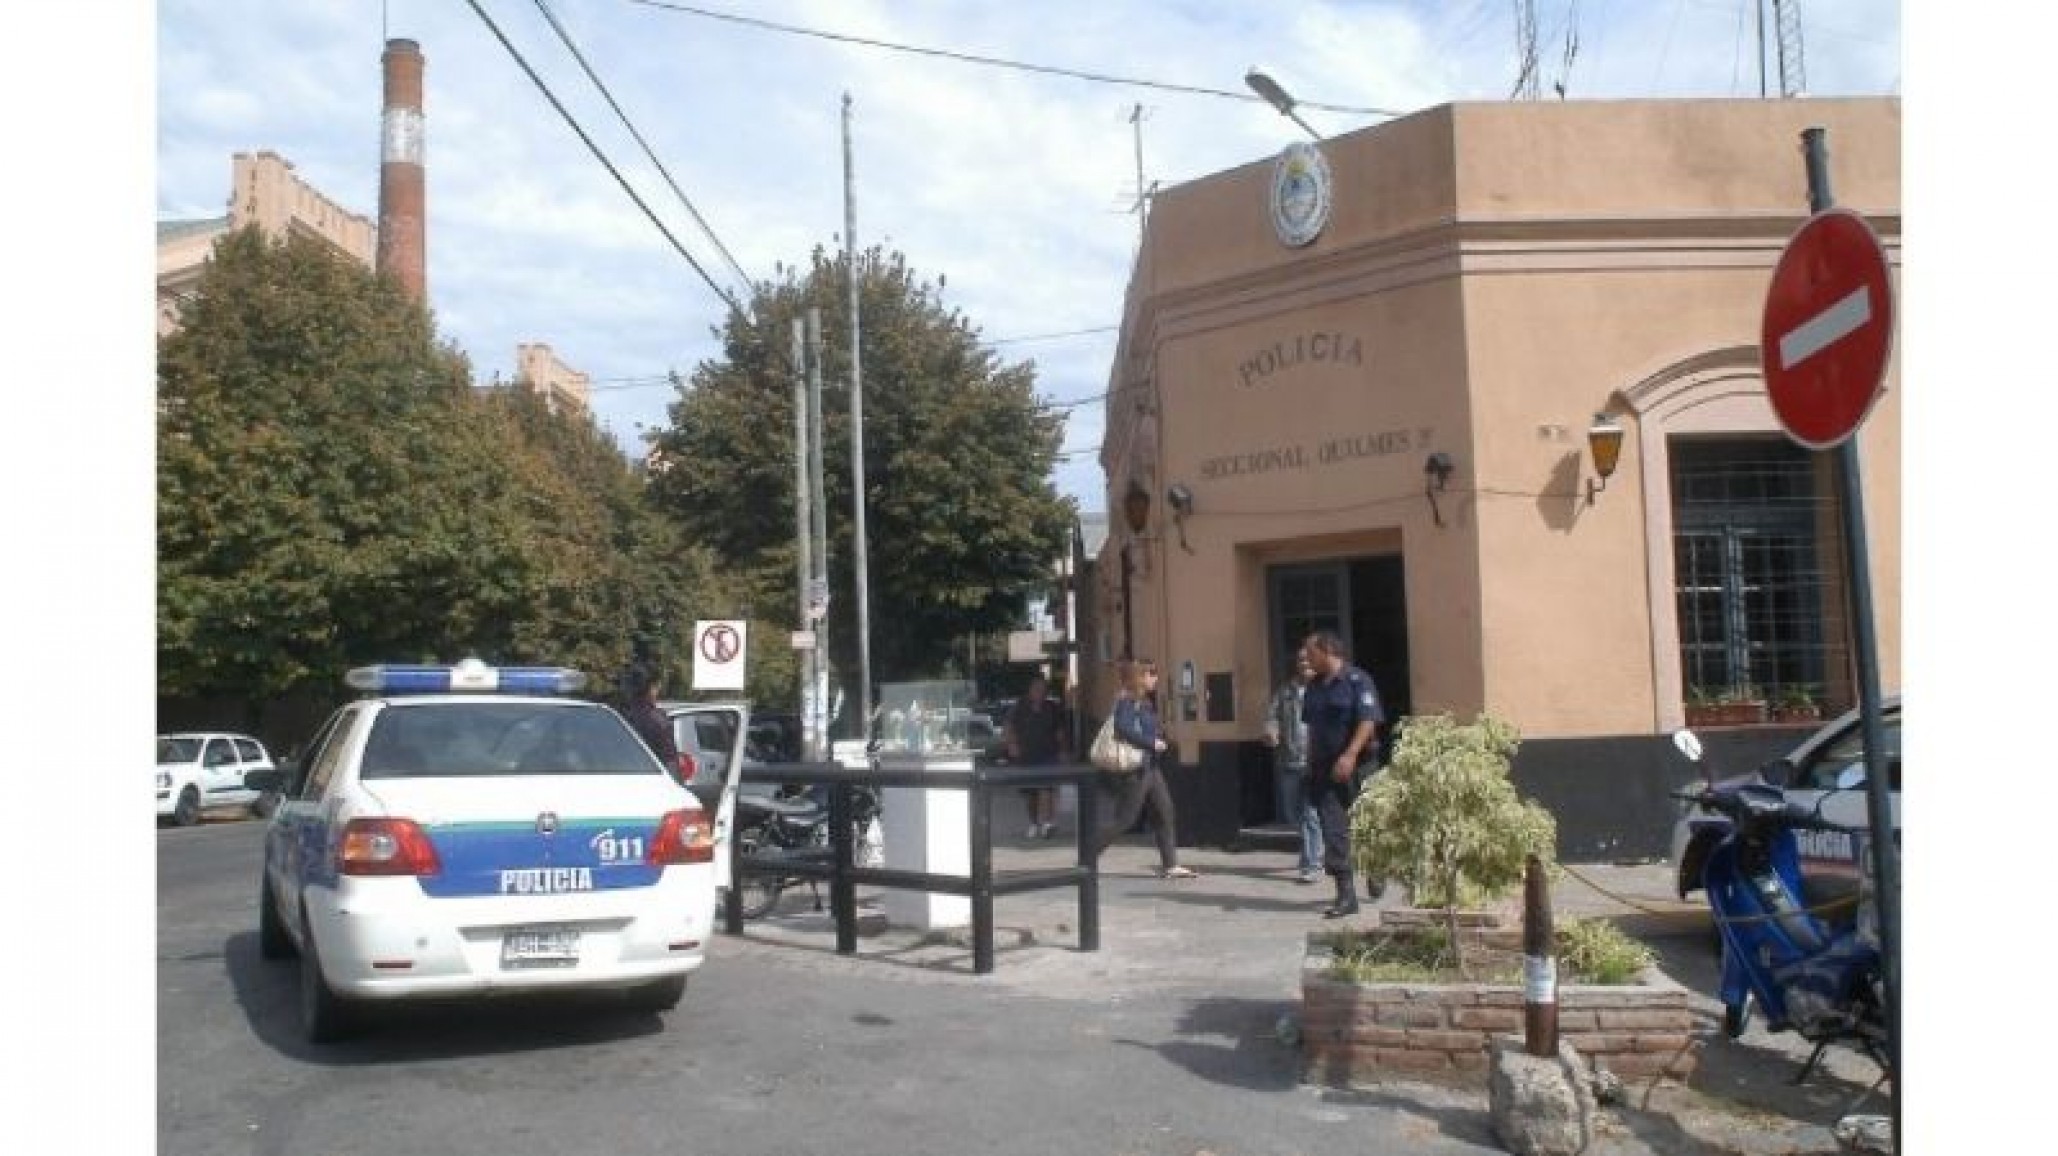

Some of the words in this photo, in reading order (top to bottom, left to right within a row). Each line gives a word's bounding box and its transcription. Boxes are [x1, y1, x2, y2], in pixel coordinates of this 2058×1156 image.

[1238, 332, 1362, 387] POLICIA
[600, 838, 642, 860] 911
[1796, 830, 1852, 858] OLICIA
[501, 867, 592, 892] POLICIA
